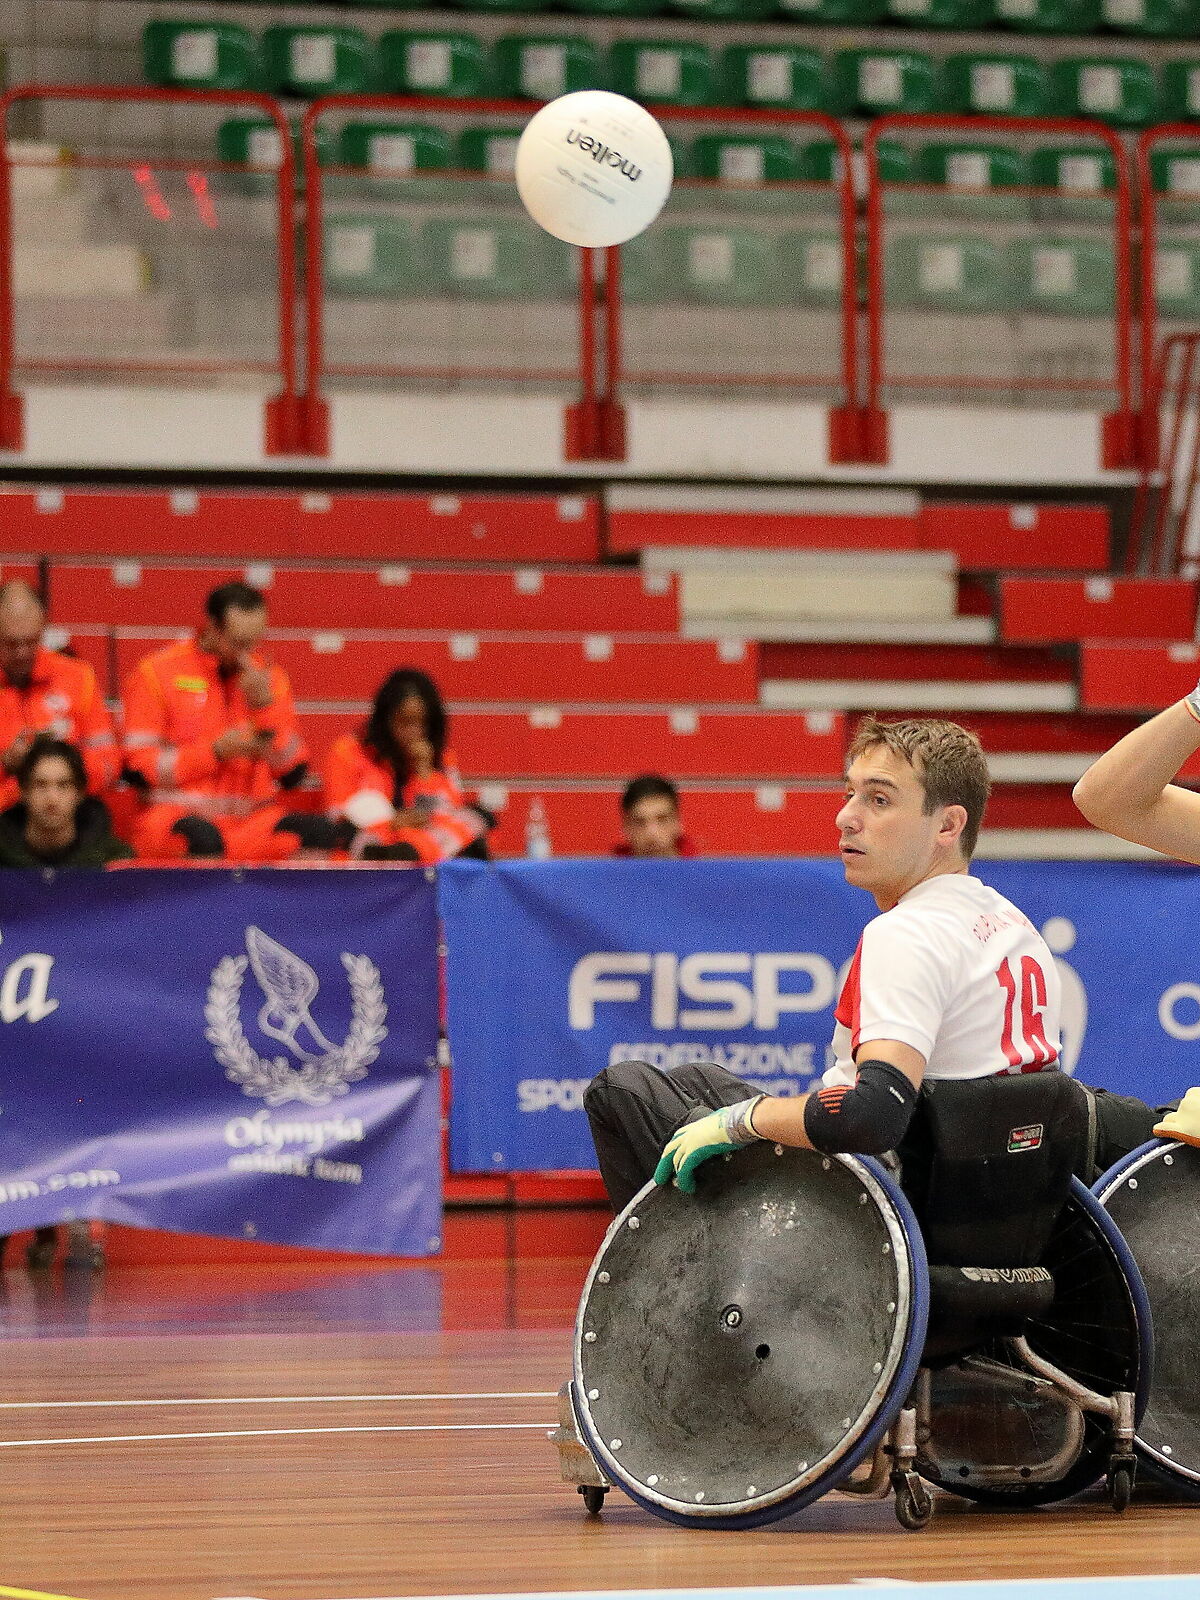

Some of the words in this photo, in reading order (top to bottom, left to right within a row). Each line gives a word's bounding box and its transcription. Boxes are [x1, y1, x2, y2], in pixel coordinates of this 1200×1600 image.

[565, 128, 642, 182] molten
[568, 951, 850, 1031] FISP
[995, 955, 1058, 1077] 16
